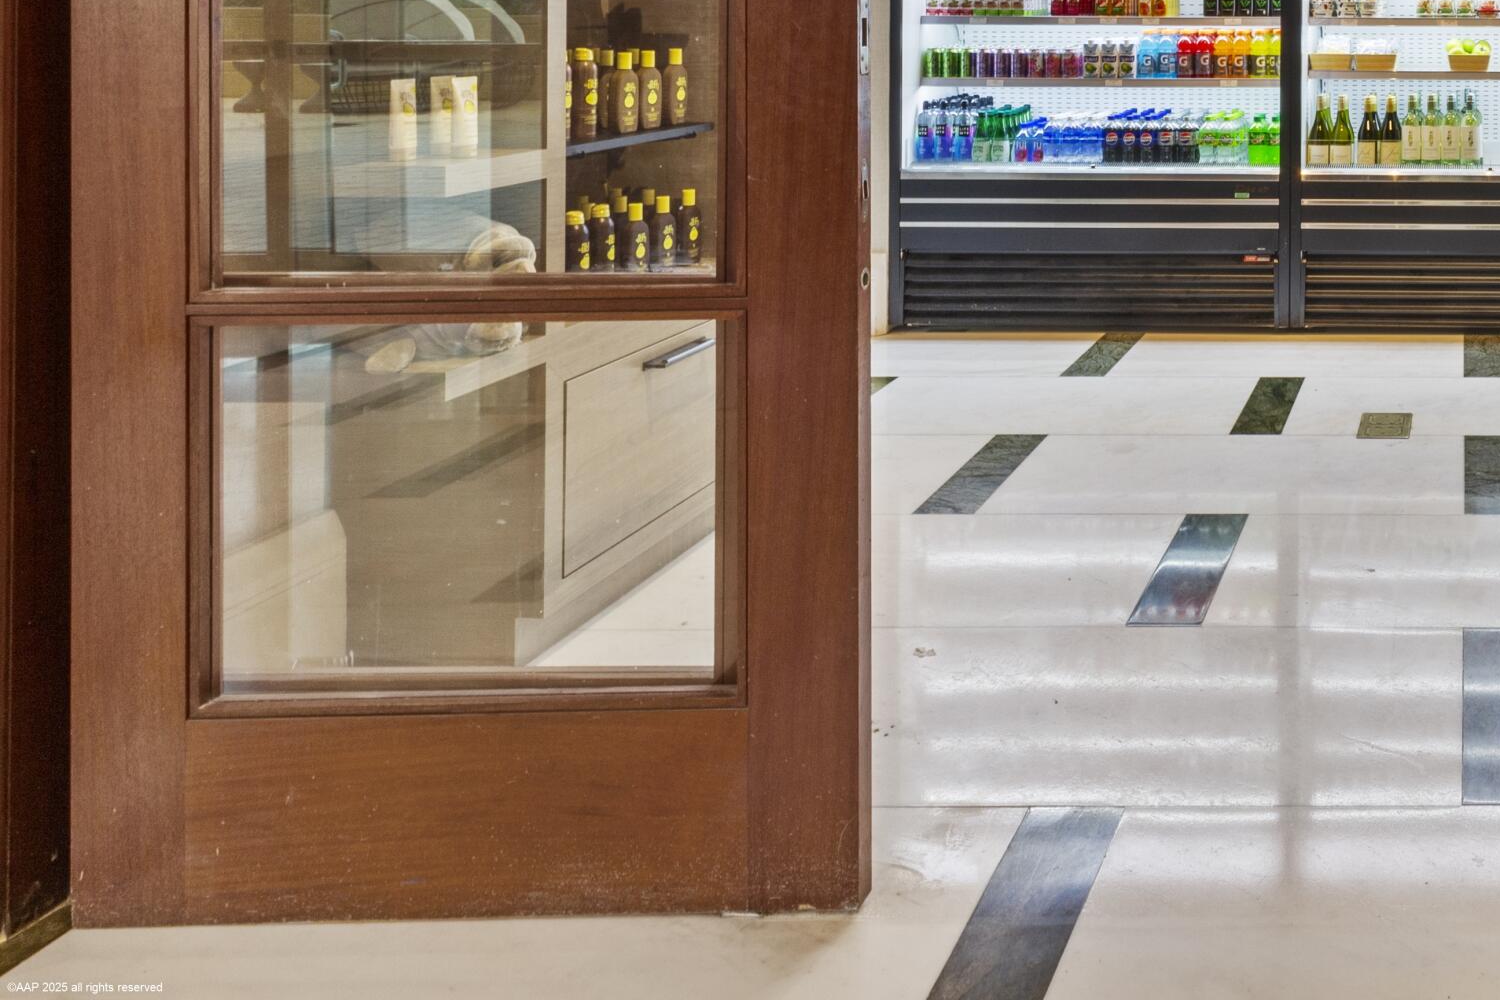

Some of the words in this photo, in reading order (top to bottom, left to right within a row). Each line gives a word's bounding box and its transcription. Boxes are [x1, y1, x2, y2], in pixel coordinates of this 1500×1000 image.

[1142, 56, 1151, 66] G
[1160, 54, 1169, 64] G
[1179, 56, 1188, 67] G
[1201, 54, 1209, 65] G
[1217, 57, 1227, 67] G
[1234, 55, 1244, 66] G
[1256, 56, 1266, 67] G
